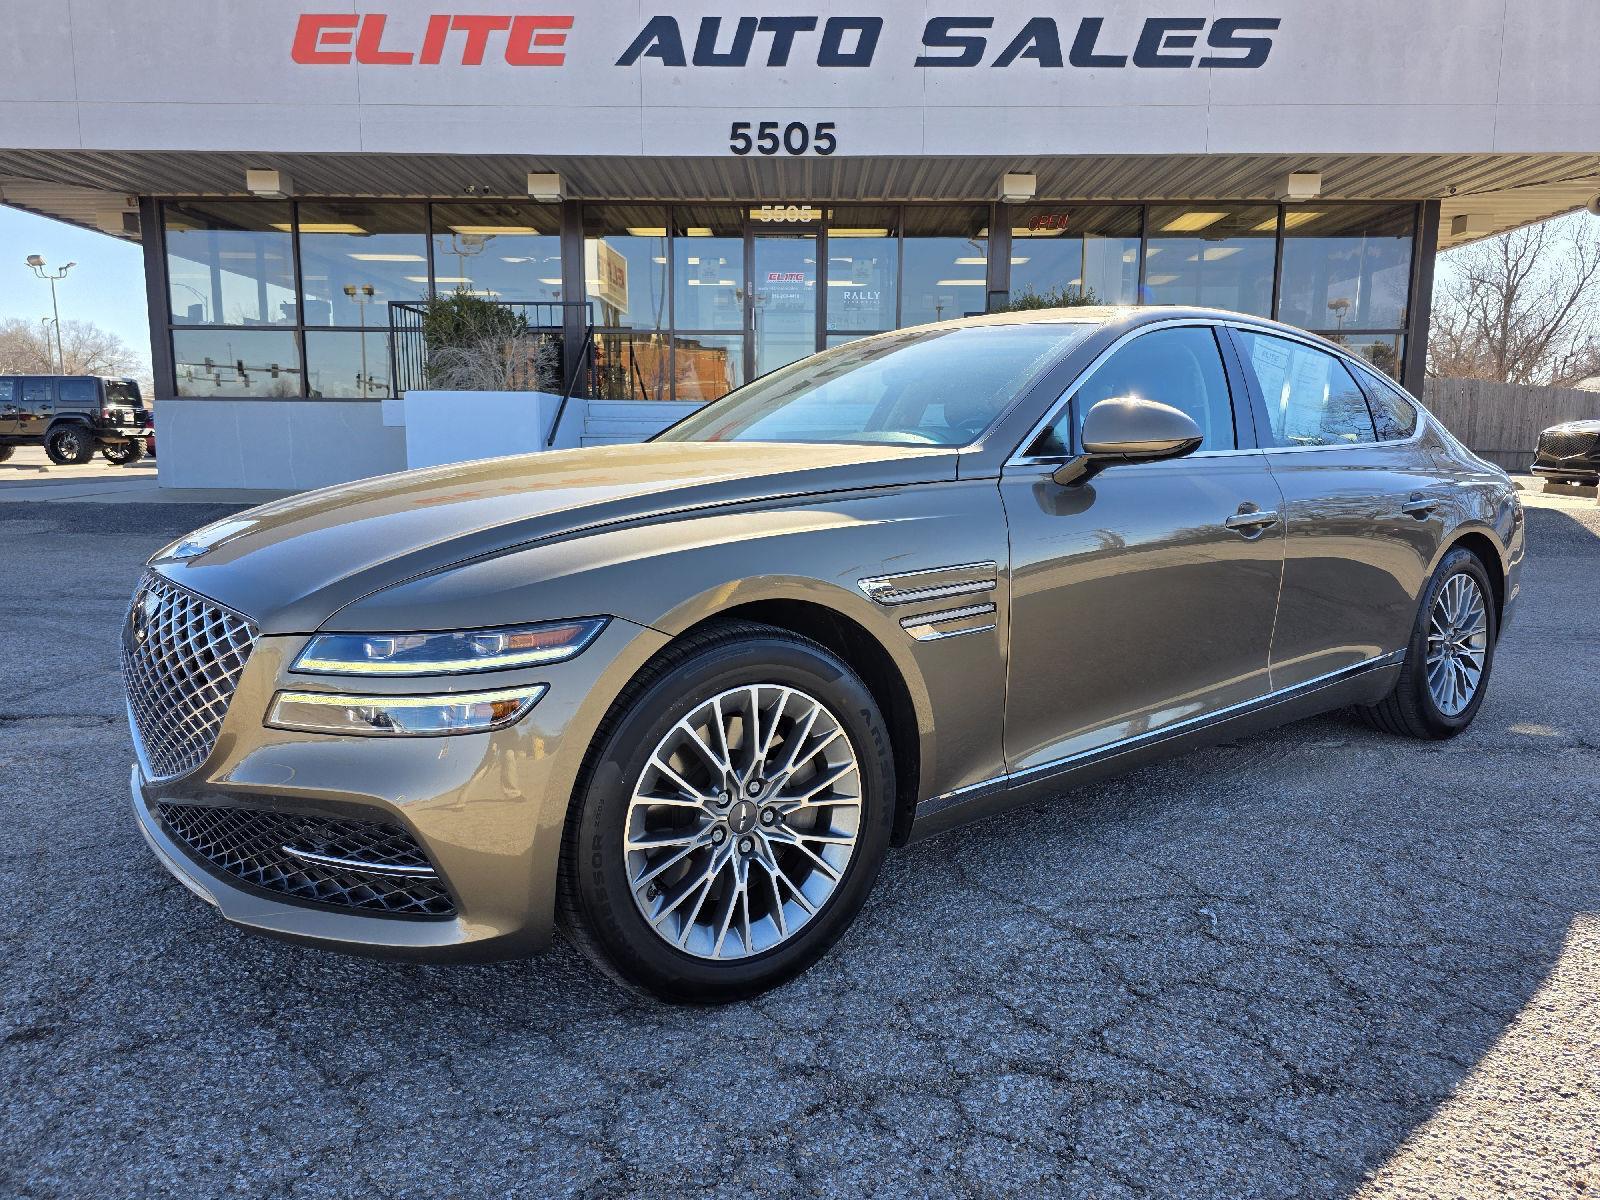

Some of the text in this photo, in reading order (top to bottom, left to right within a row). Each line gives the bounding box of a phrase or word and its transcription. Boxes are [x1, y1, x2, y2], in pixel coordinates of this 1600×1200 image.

[291, 14, 1281, 69] ELITE AUTO SALES
[730, 121, 837, 156] 5505
[760, 205, 812, 223] 5505
[1028, 214, 1069, 231] OPEN
[767, 272, 804, 280] ELITE
[843, 291, 881, 300] RALLY
